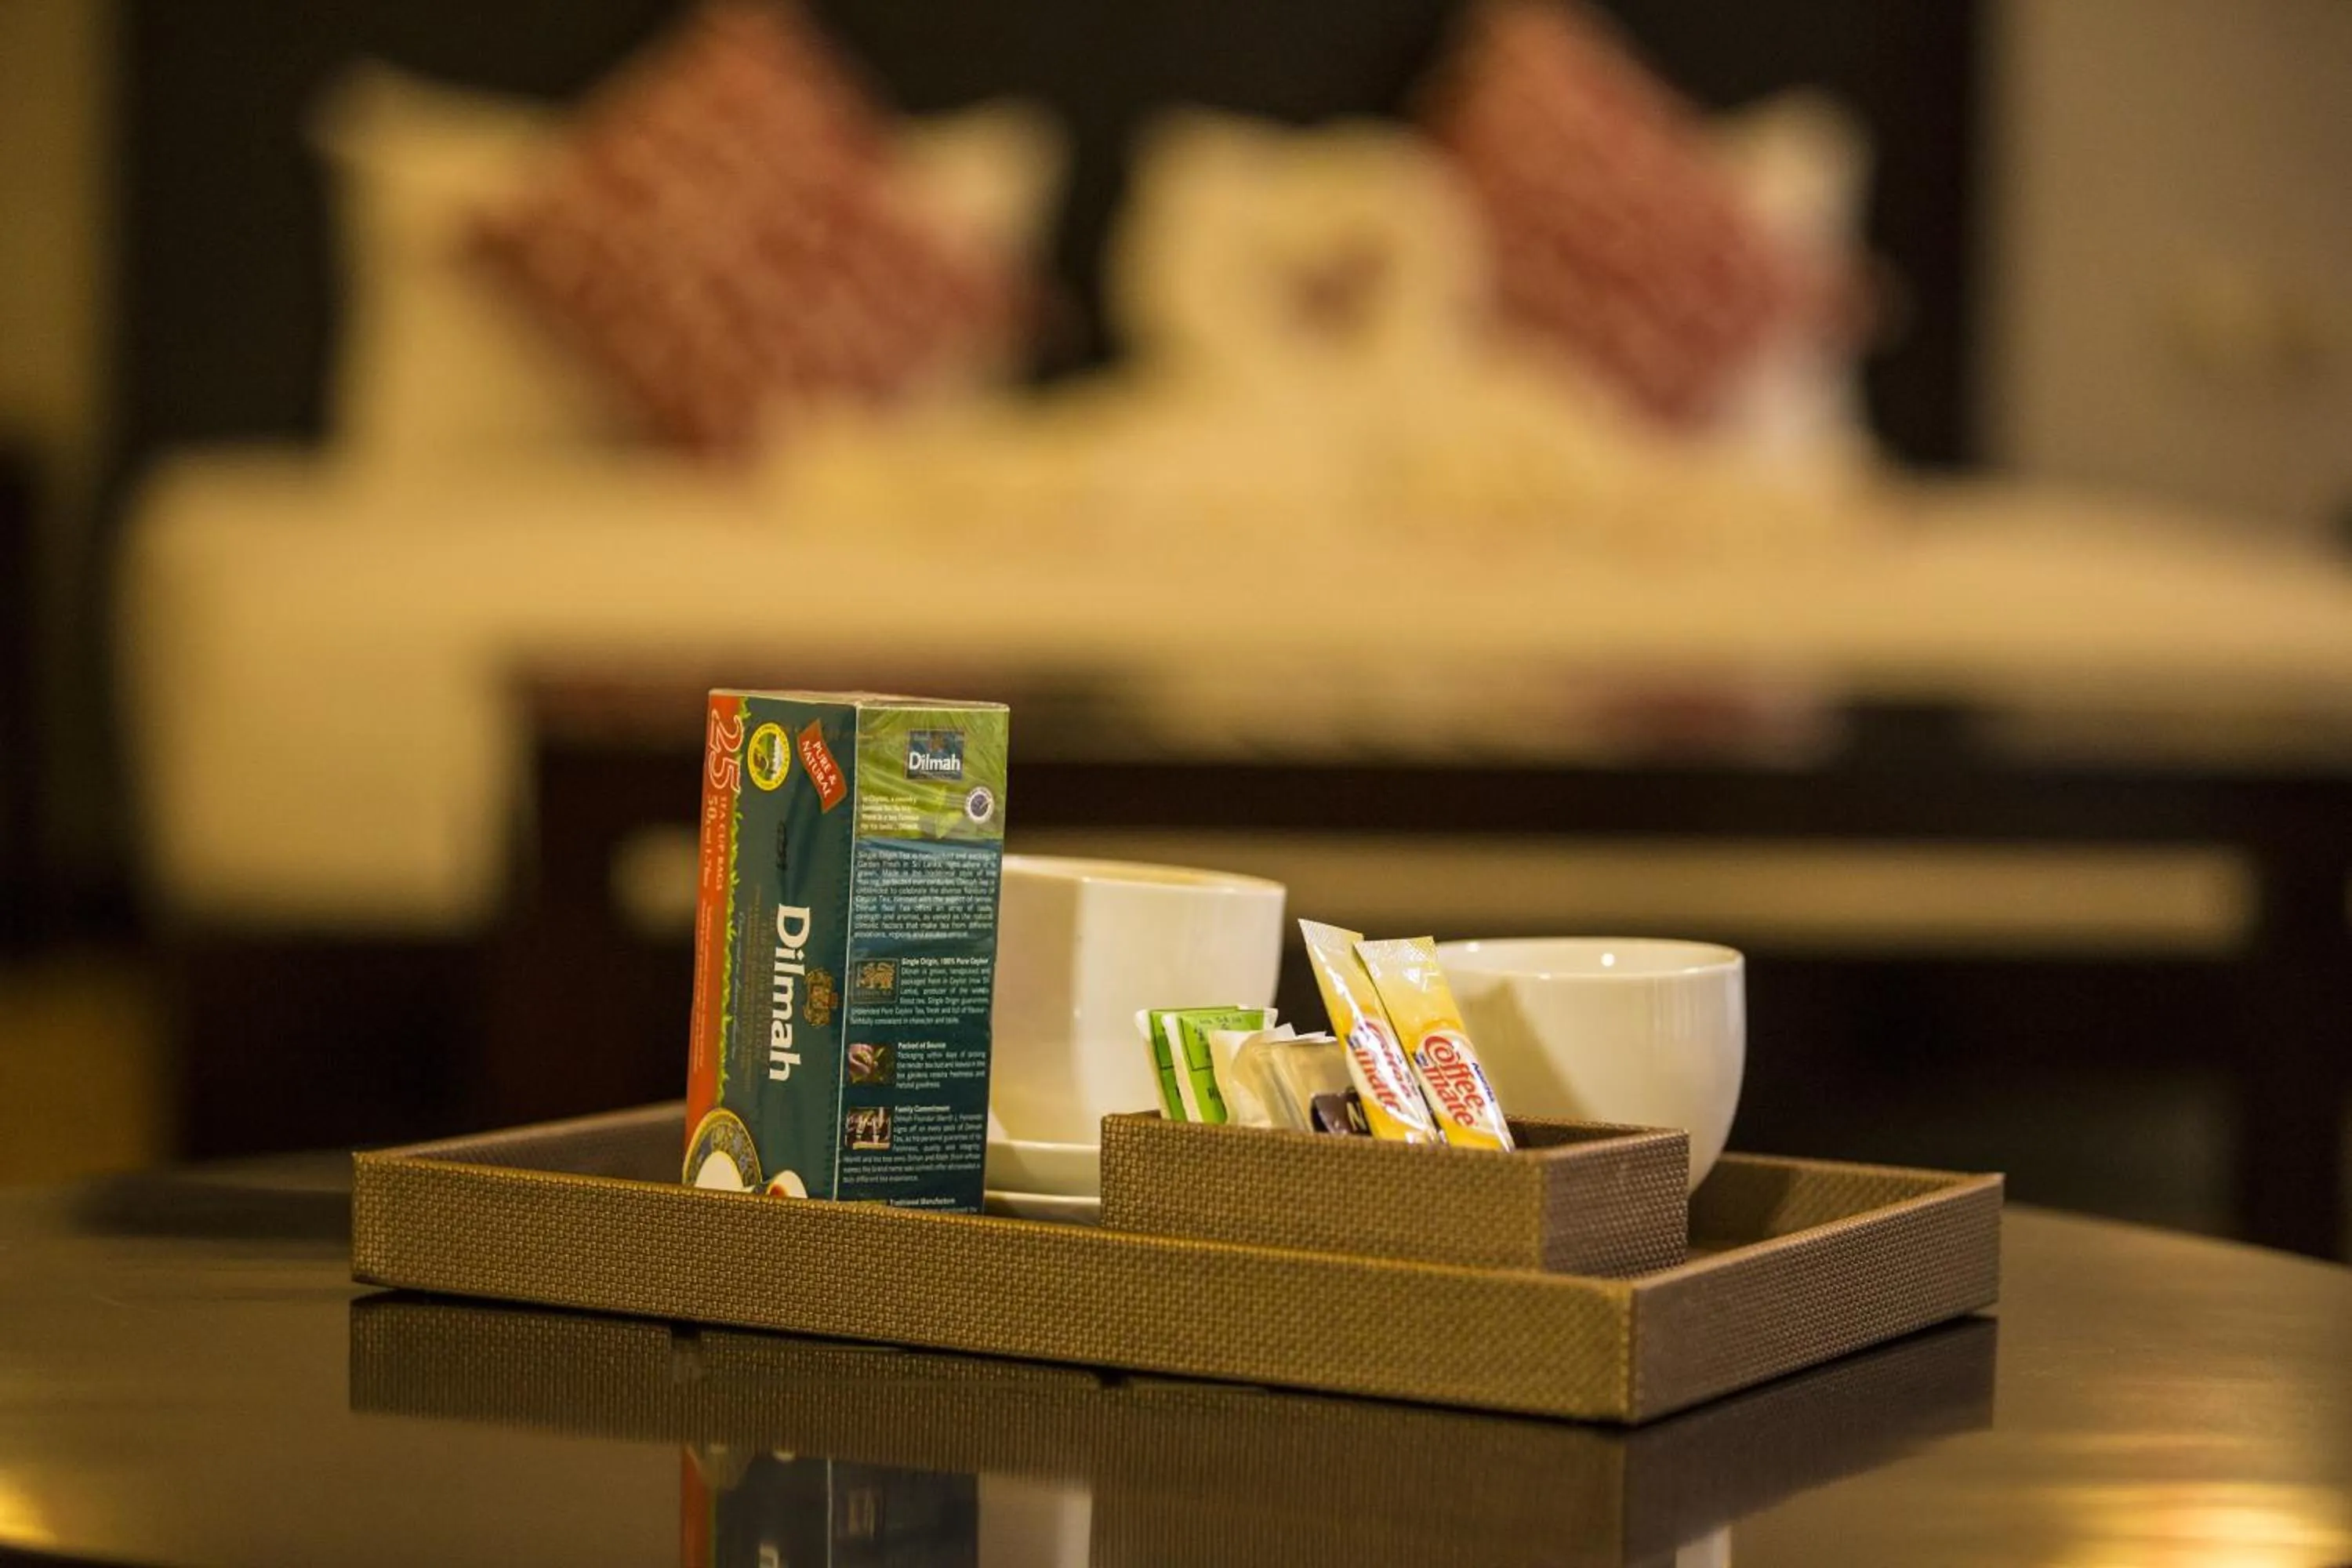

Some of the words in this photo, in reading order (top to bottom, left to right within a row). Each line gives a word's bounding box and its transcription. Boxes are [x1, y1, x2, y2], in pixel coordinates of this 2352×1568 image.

[708, 709, 744, 793] 25
[801, 740, 833, 798] NATURAL
[811, 741, 832, 773] PURE
[829, 774, 837, 785] &
[909, 751, 960, 771] Dilmah
[717, 823, 726, 854] CUP
[715, 855, 724, 892] BAGS
[769, 903, 811, 1082] Dilmah
